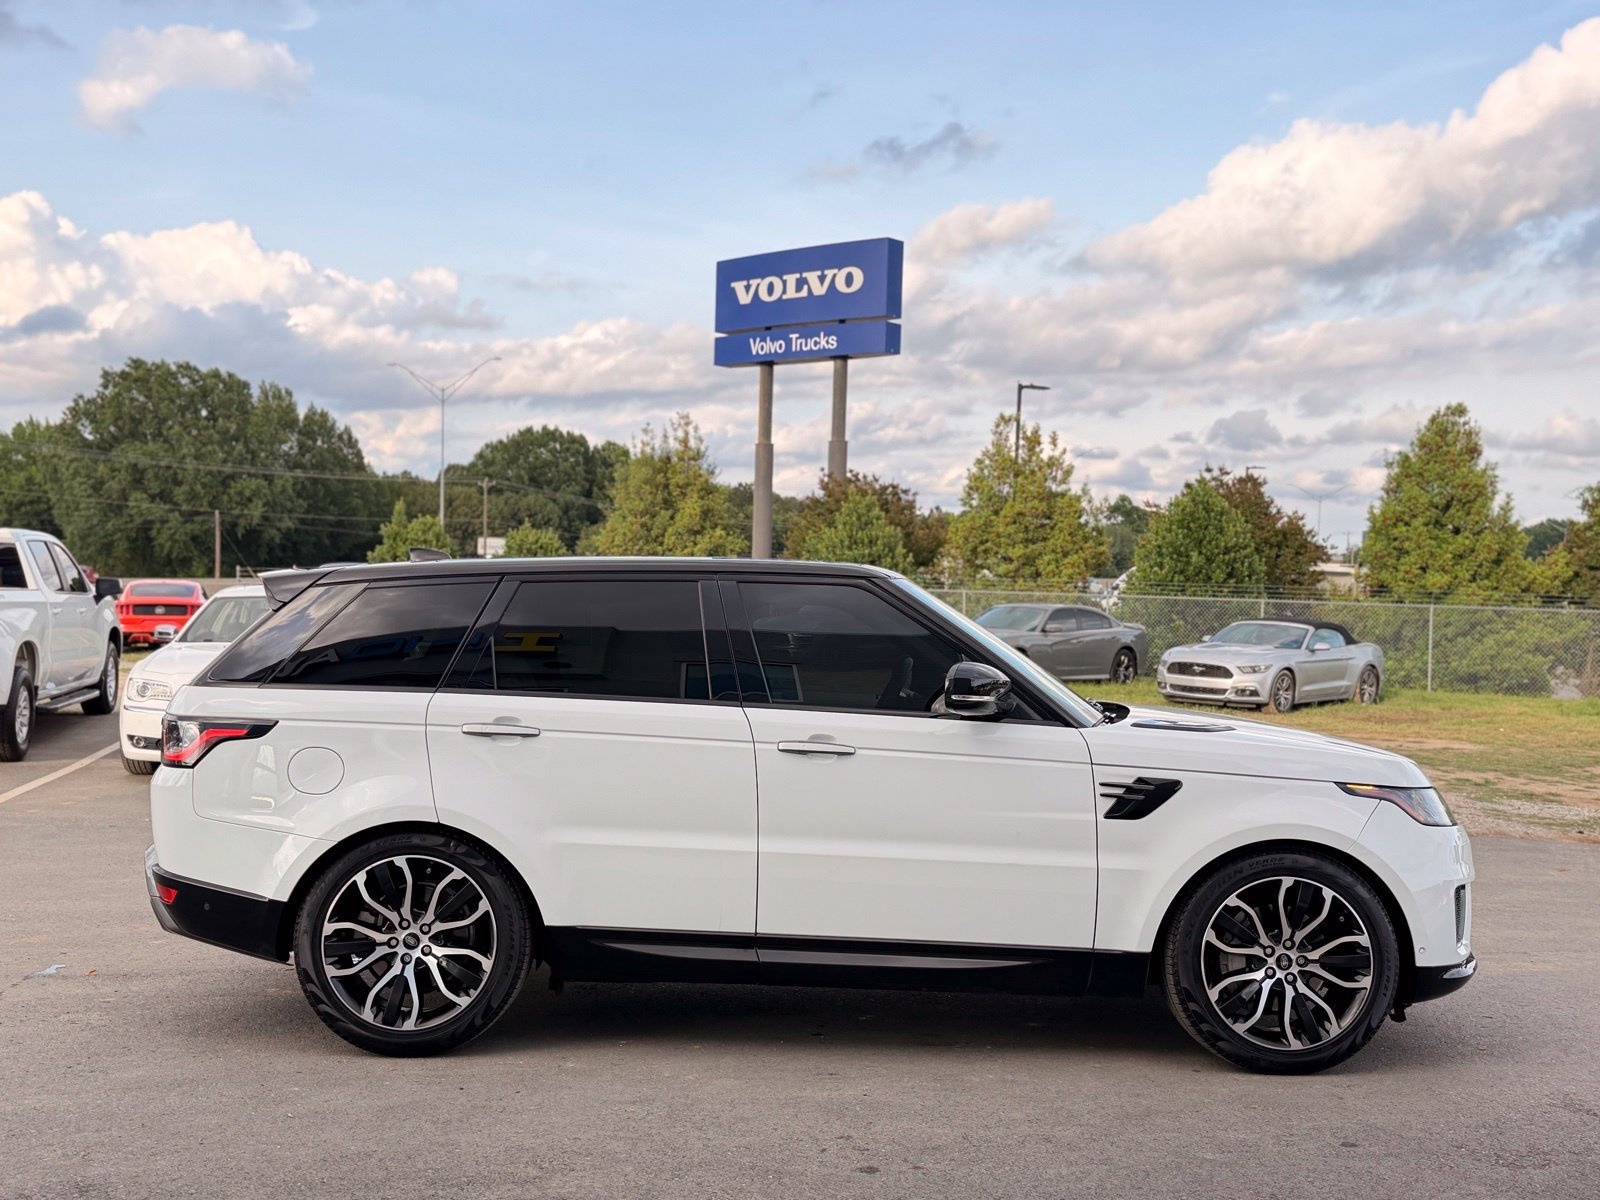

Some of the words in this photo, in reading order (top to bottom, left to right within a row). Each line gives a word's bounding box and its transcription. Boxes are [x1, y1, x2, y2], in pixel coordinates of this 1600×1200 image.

[730, 266, 864, 305] VOLVO
[749, 336, 786, 355] Volvo
[789, 332, 837, 352] Trucks
[1248, 856, 1286, 867] VERDE
